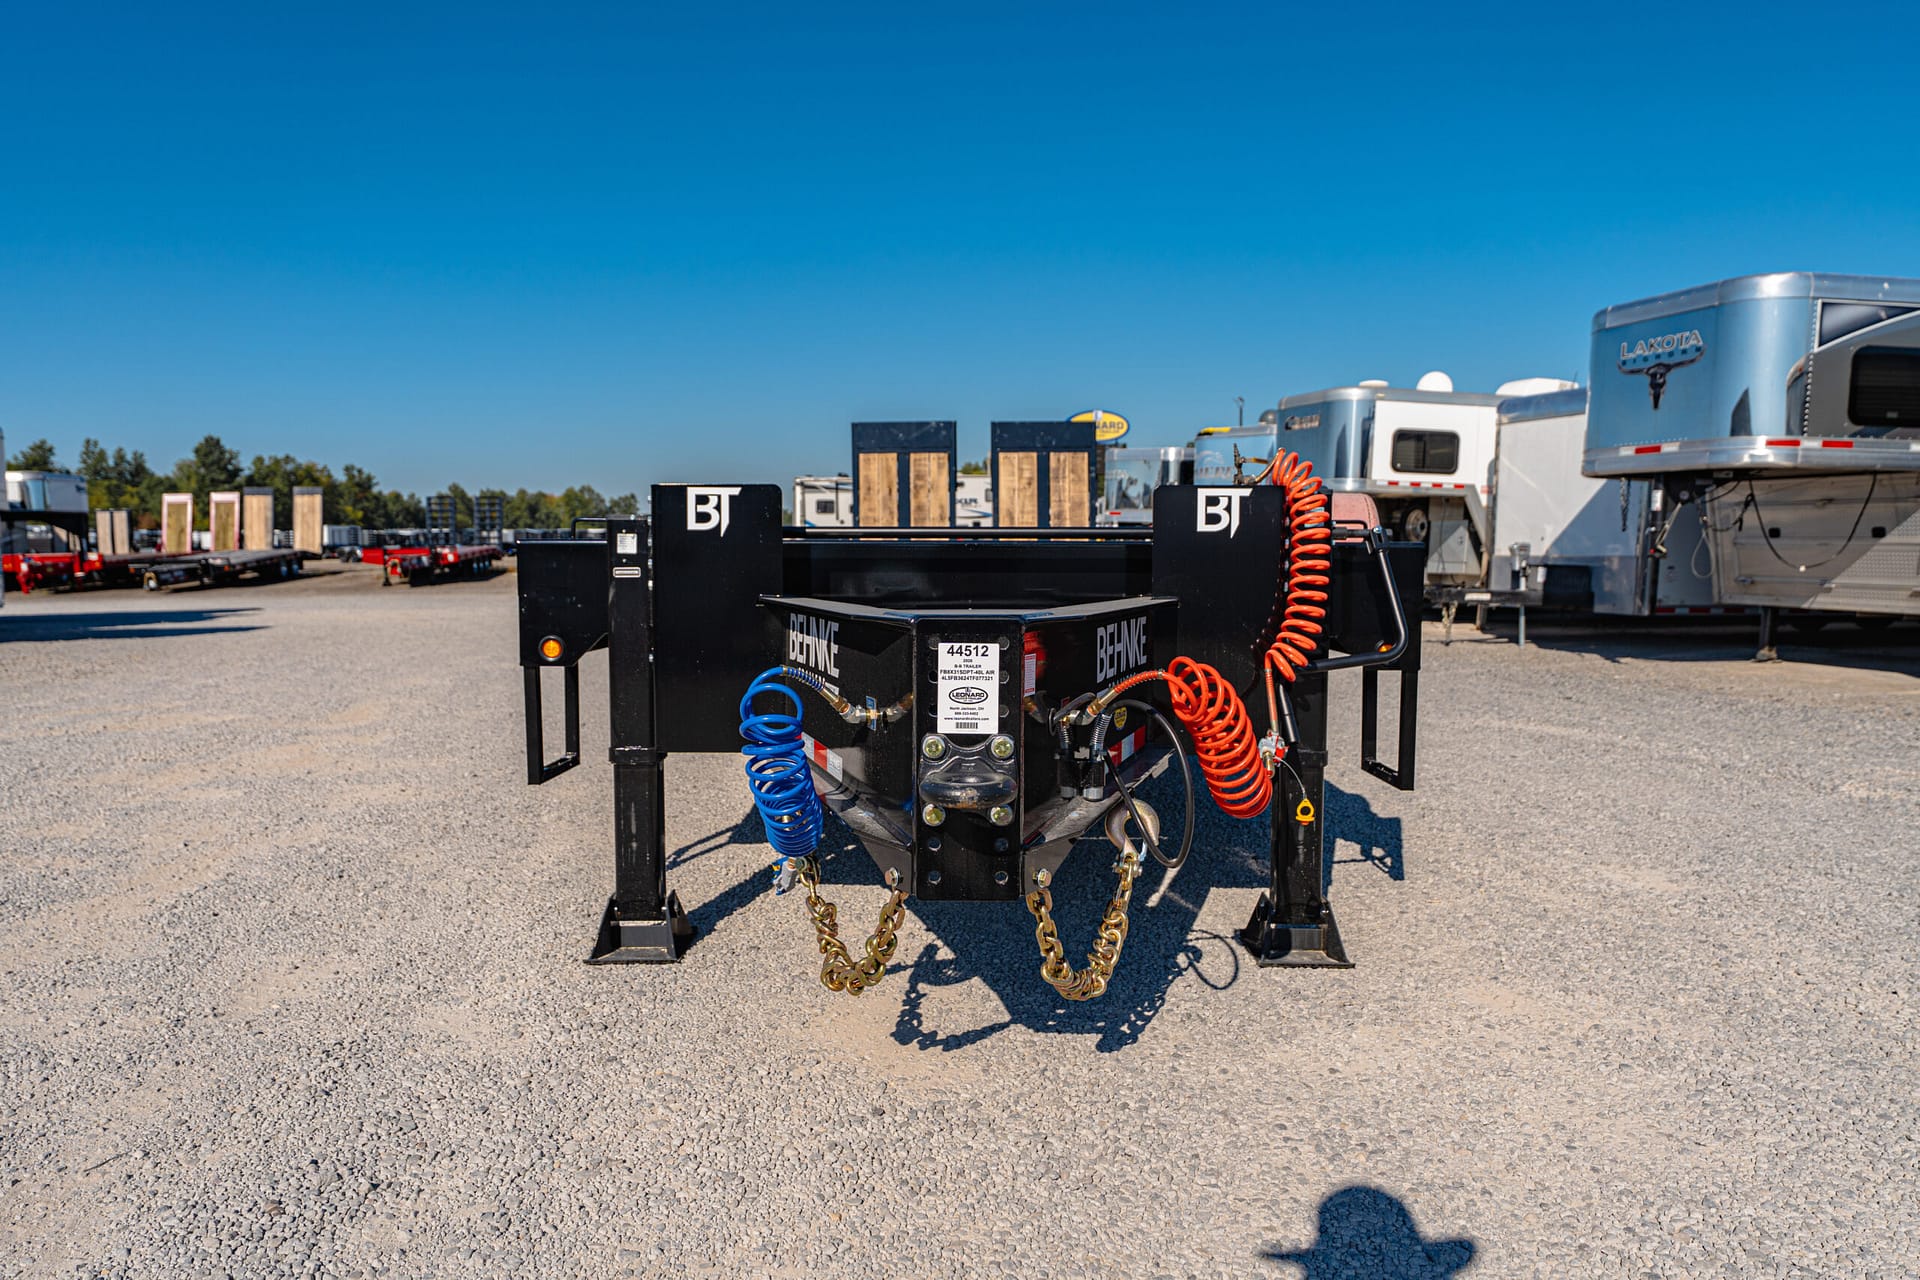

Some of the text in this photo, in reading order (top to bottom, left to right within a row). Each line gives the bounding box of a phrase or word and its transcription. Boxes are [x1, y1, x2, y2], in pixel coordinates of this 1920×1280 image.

[1621, 329, 1703, 359] LAKOTA
[686, 487, 742, 537] BT
[1197, 488, 1253, 539] BT
[789, 613, 839, 678] BEHNKE
[947, 645, 989, 657] 44512
[1096, 616, 1147, 683] BEHNKE
